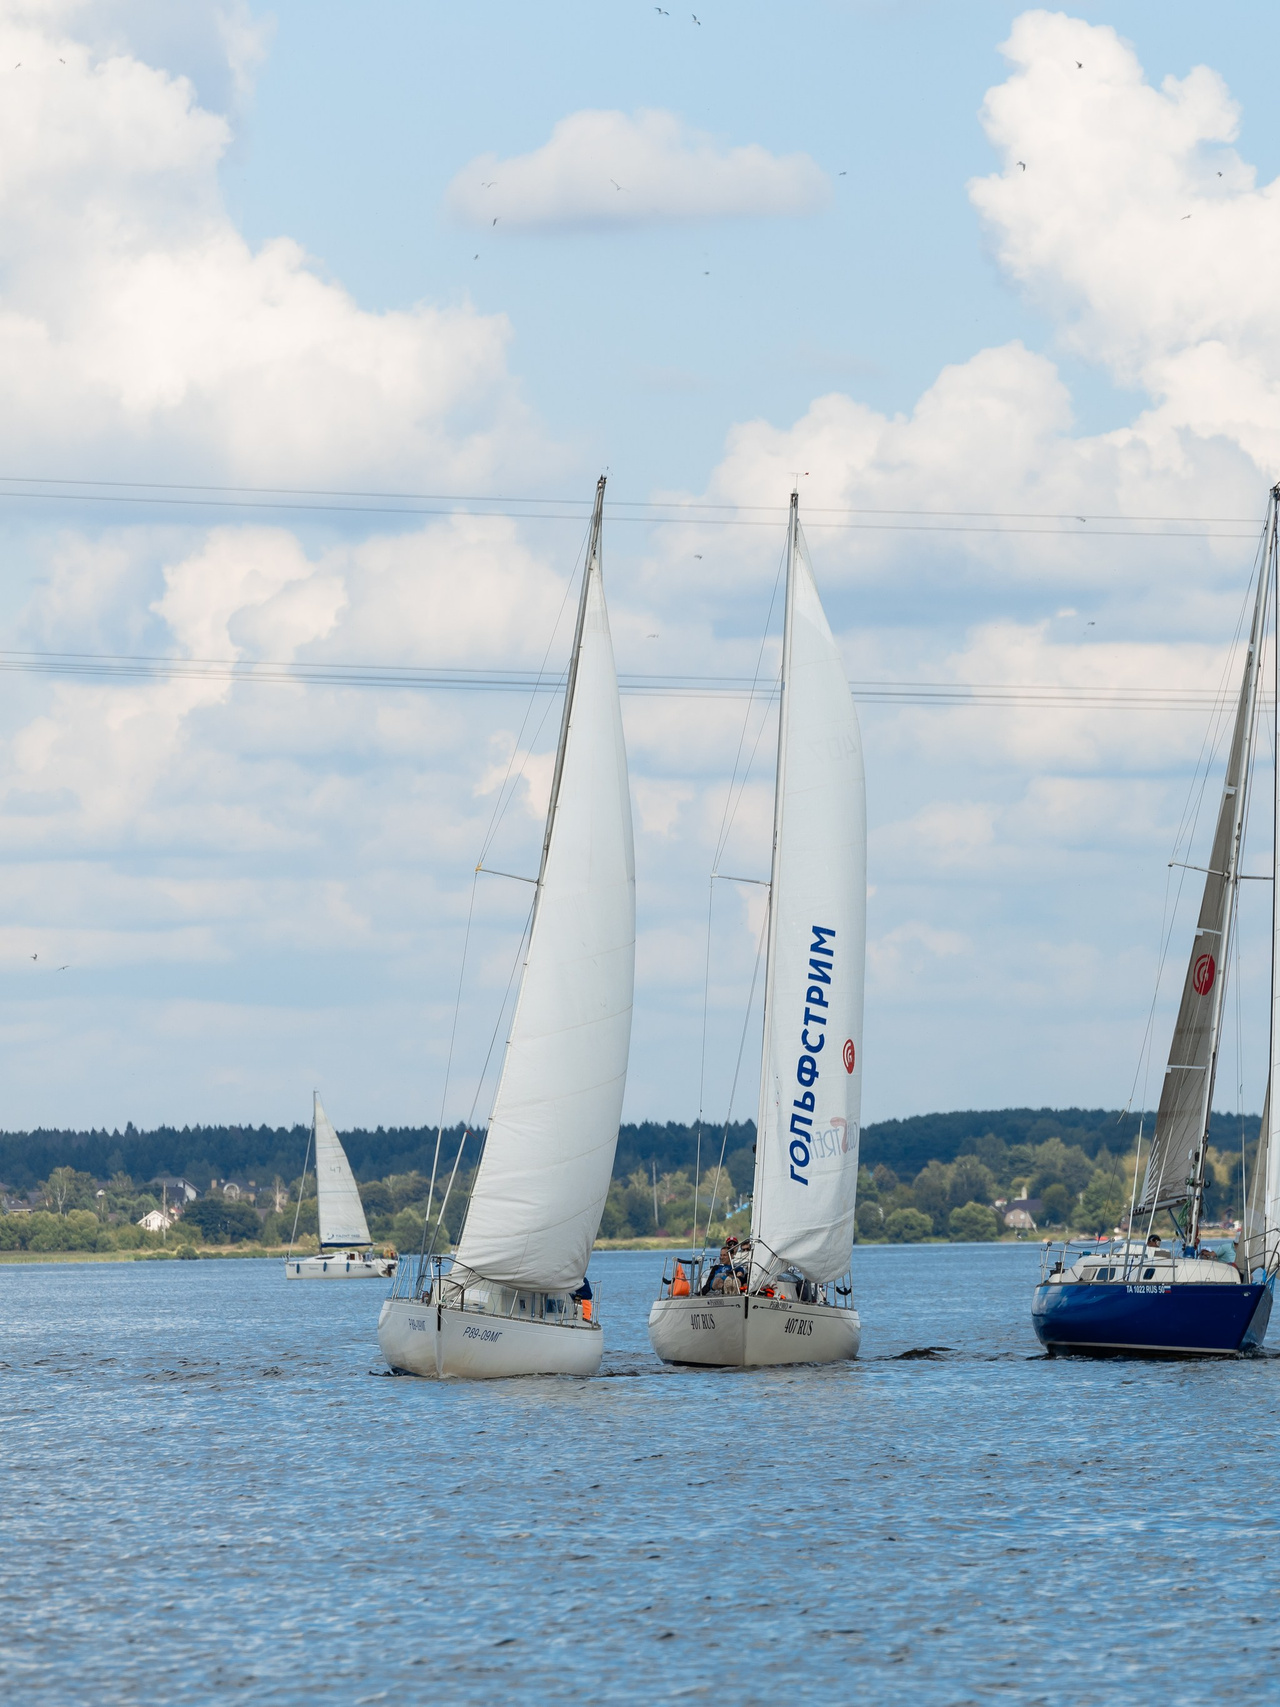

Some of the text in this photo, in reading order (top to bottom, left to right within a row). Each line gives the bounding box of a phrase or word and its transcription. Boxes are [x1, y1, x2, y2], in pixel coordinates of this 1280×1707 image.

[789, 925, 836, 1186] ГОЛЬФСТРИМ
[1126, 1285, 1133, 1293] TA
[1146, 1285, 1157, 1293] RUS
[690, 1313, 716, 1330] 407 RUS
[784, 1317, 814, 1336] 407 RUS
